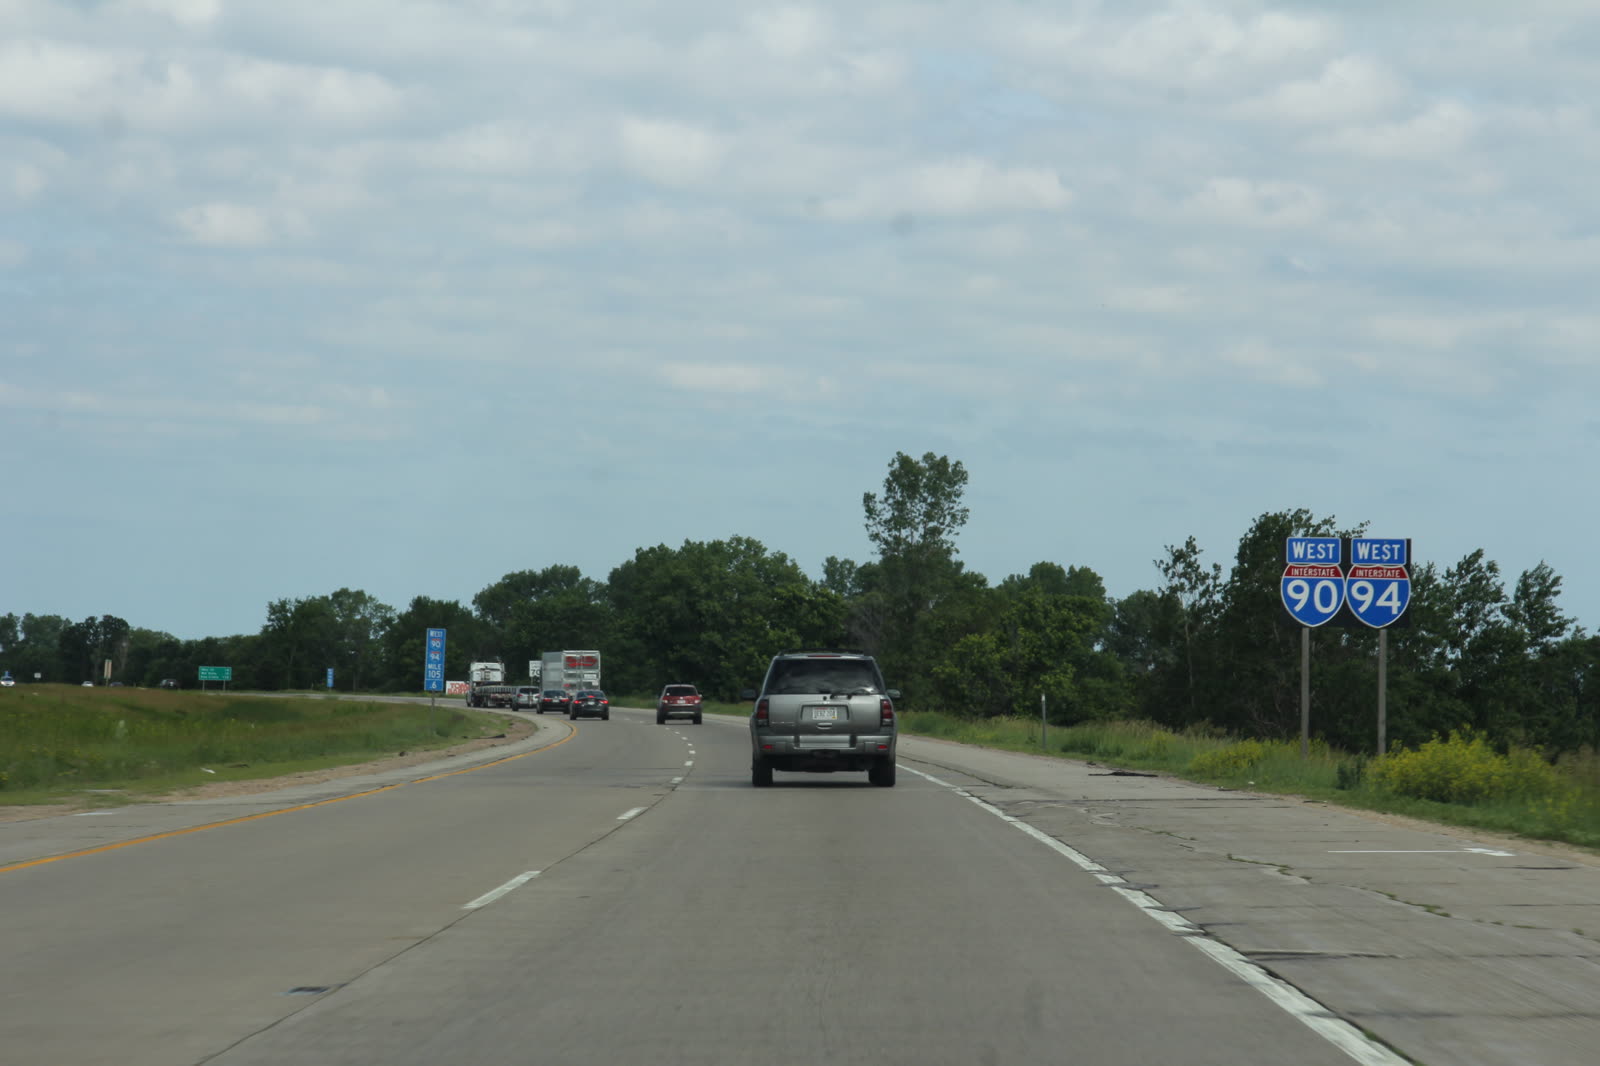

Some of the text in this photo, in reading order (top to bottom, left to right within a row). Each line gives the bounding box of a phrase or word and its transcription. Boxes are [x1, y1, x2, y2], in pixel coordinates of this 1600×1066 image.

[1292, 541, 1335, 559] WEST
[1357, 542, 1400, 560] WEST
[1291, 568, 1335, 577] INTERSTATE
[1356, 569, 1400, 578] INTERSTATE
[1287, 580, 1338, 614] 90
[1351, 580, 1401, 615] 94
[428, 670, 441, 678] 105
